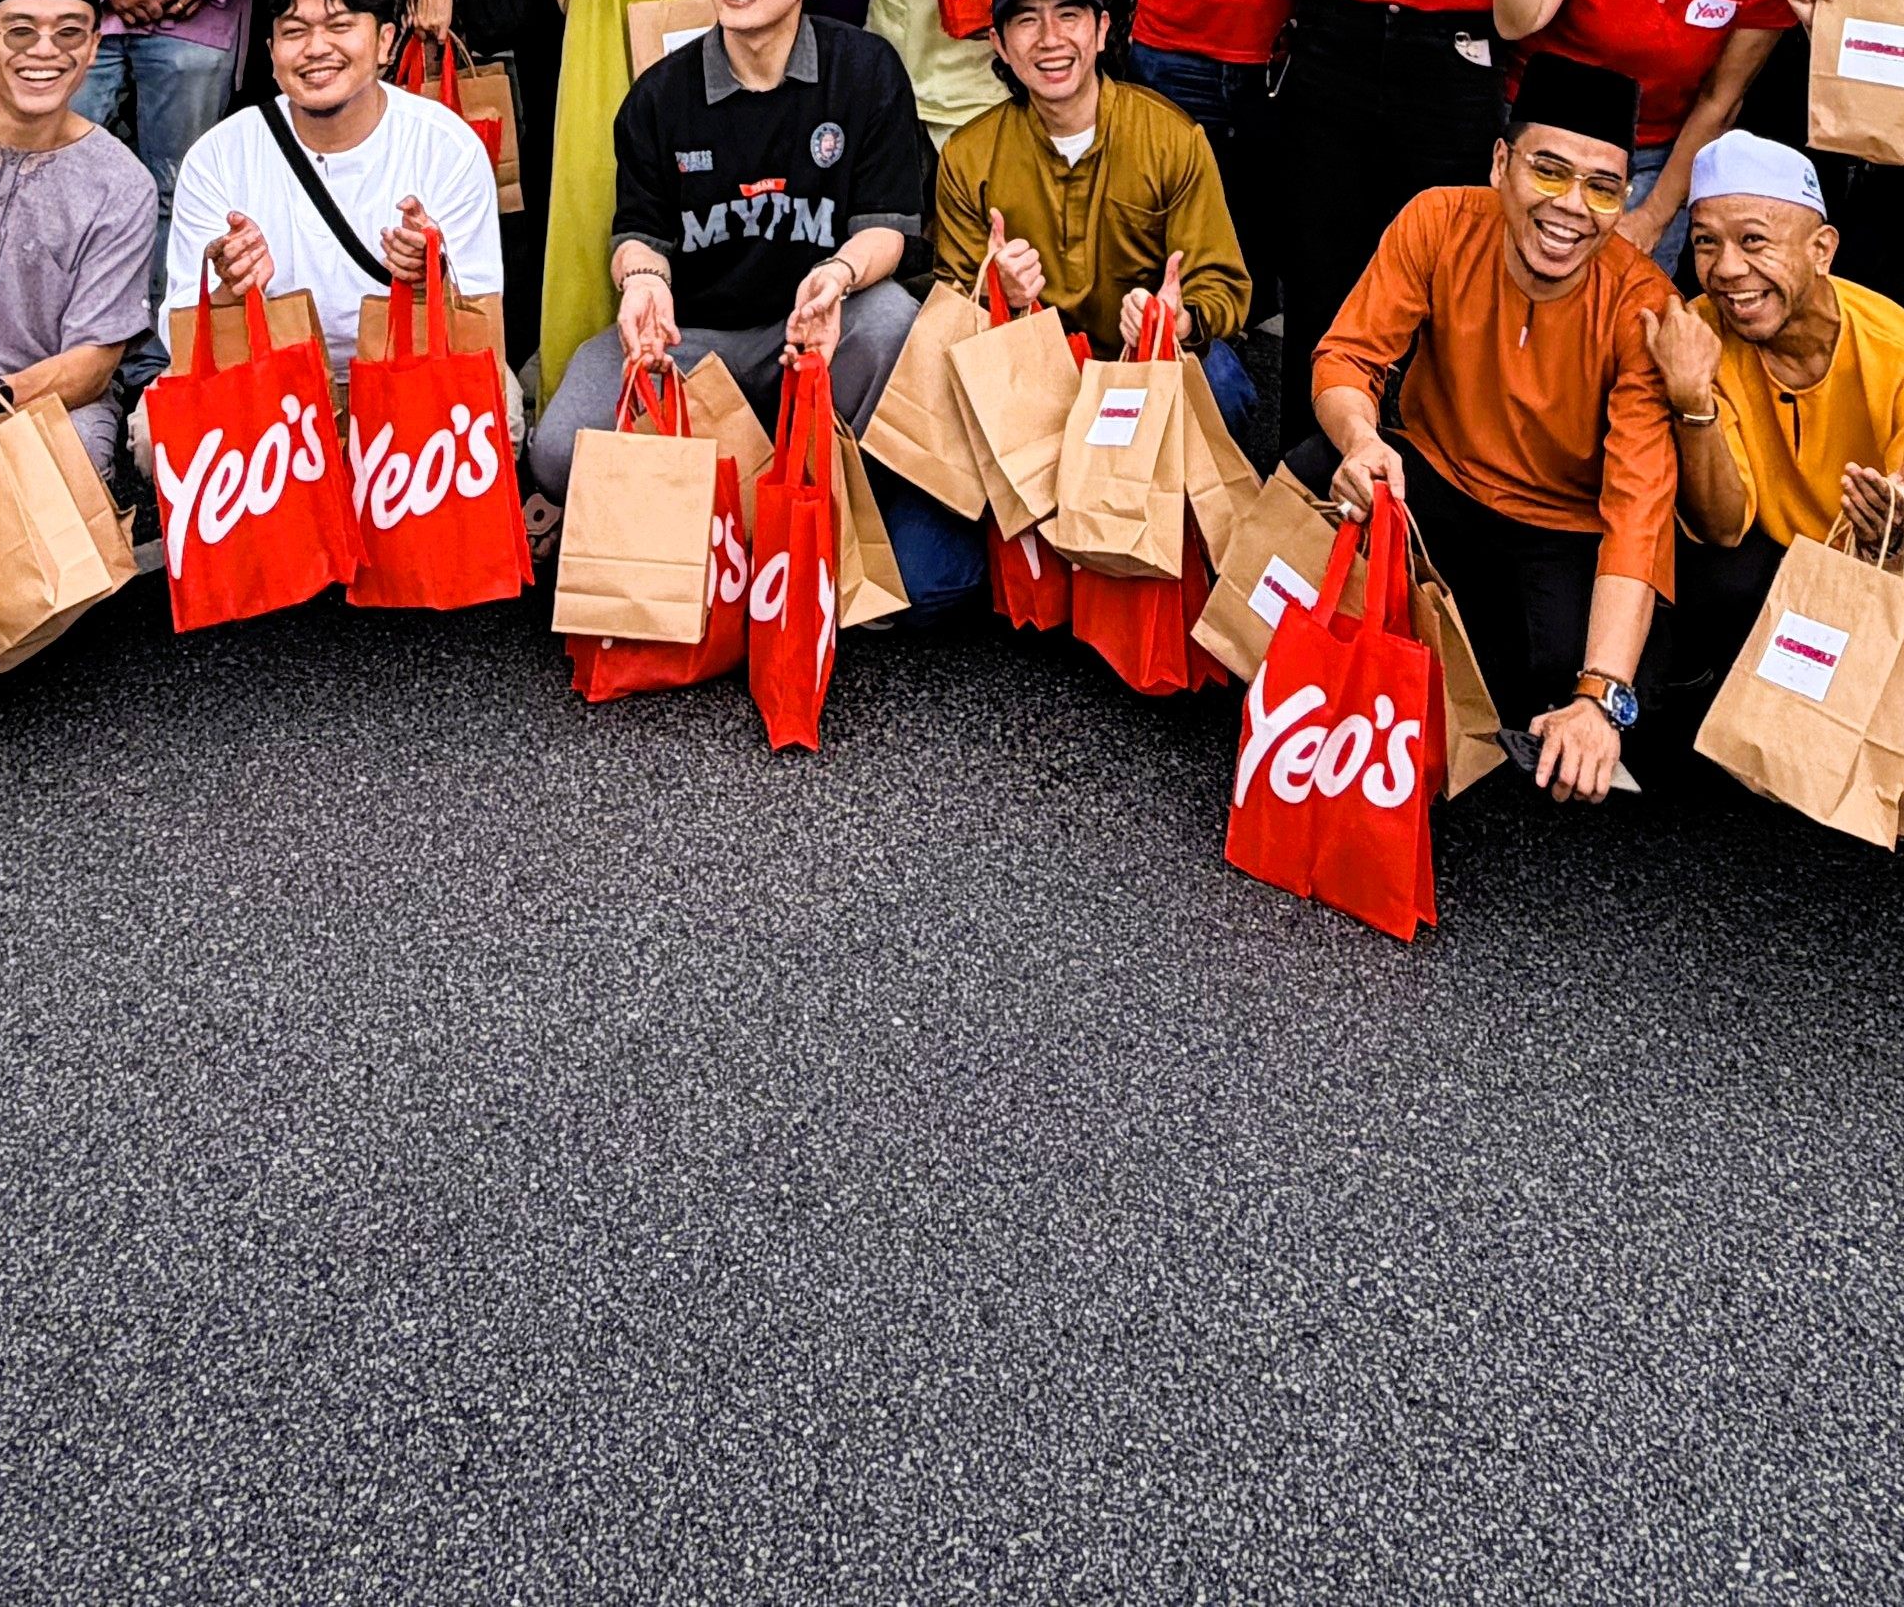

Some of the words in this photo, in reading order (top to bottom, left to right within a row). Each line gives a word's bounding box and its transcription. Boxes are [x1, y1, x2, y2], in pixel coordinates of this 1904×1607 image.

[155, 393, 326, 581] Yeo's
[348, 402, 499, 531] Yeo's
[1234, 658, 1421, 810] Yeo's
